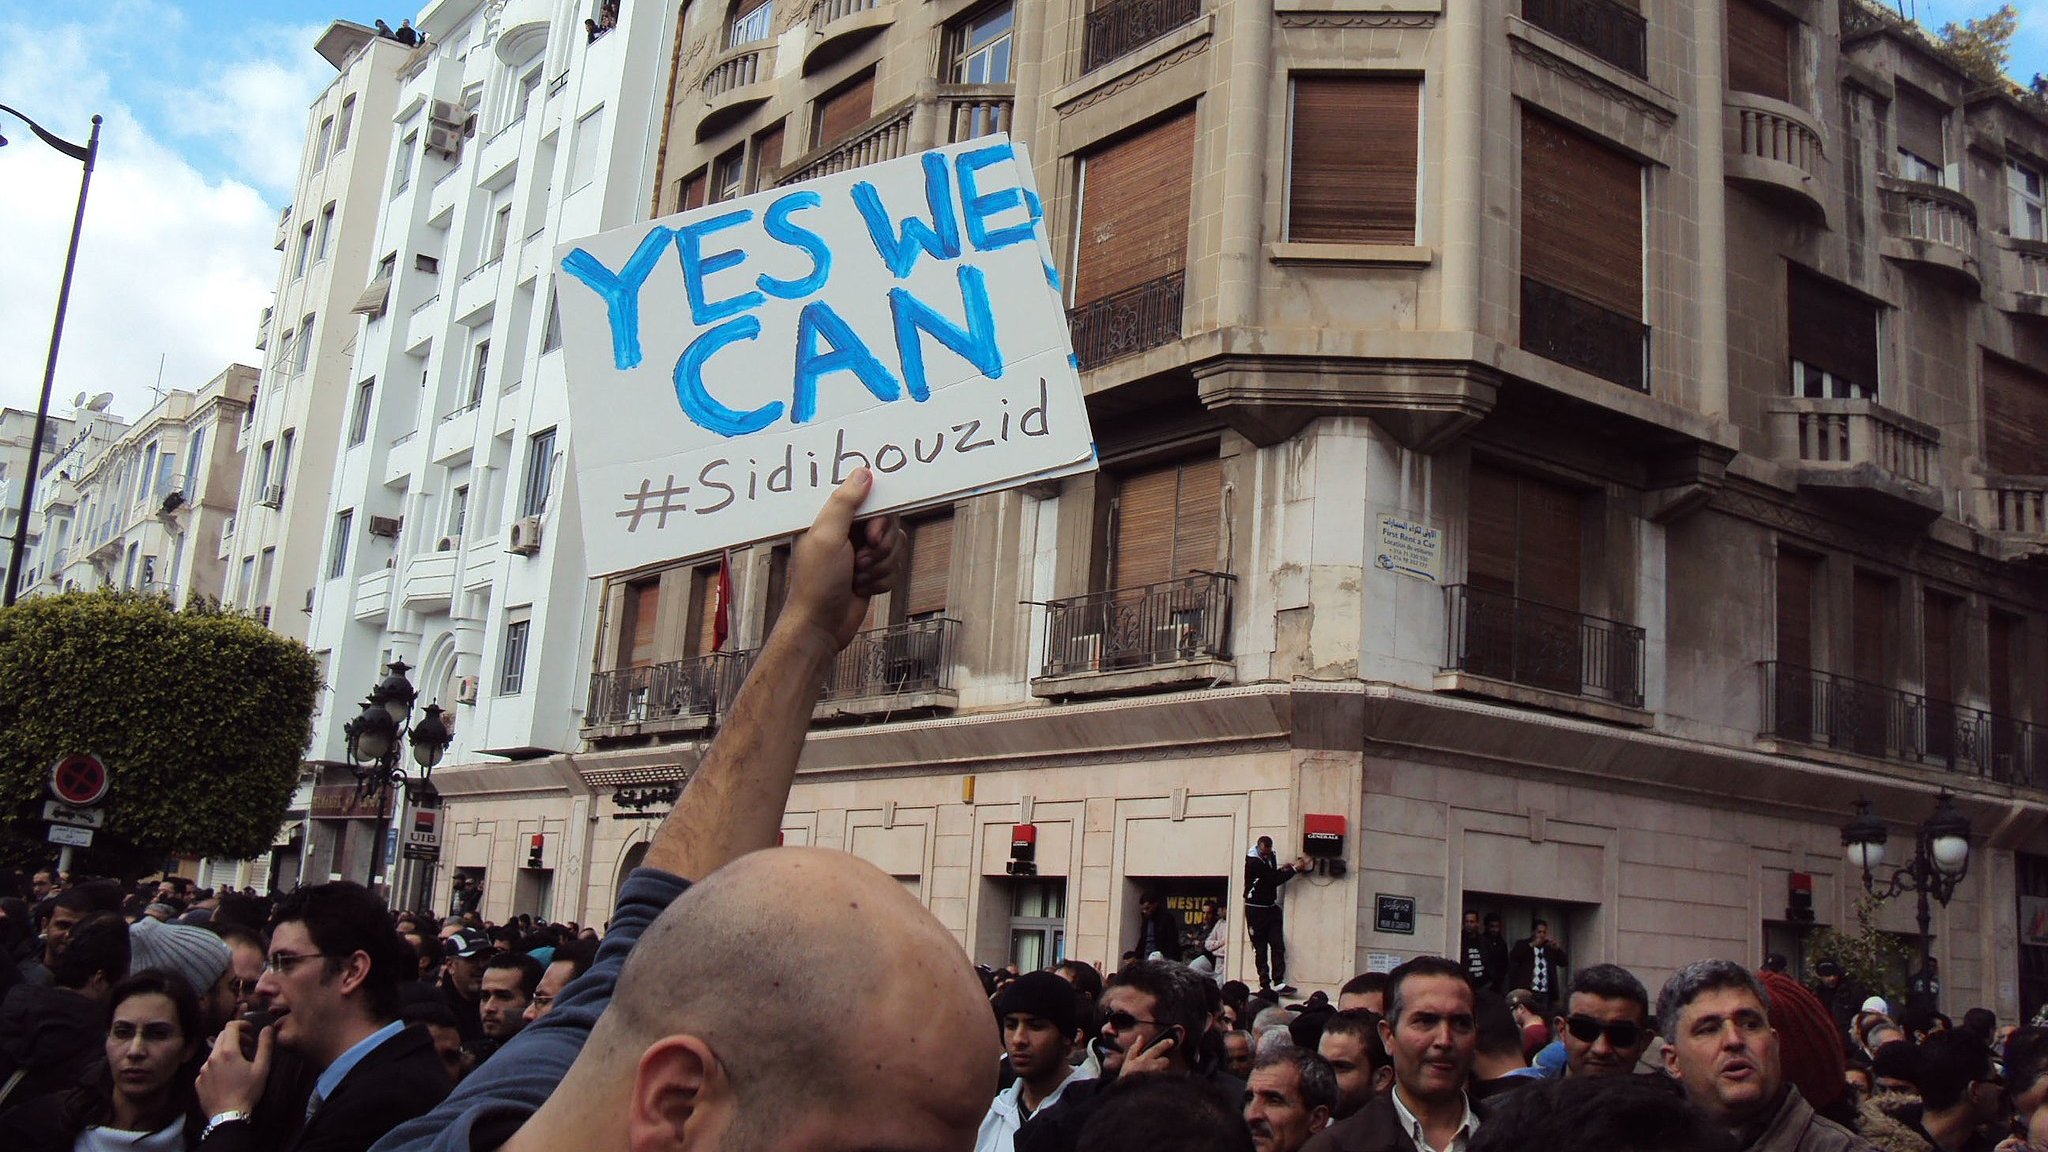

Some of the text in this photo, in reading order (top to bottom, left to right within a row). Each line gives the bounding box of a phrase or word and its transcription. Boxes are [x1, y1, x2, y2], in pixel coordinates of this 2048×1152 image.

[561, 144, 1039, 370] YES WE
[672, 264, 1003, 437] CAN
[615, 377, 1050, 533] #Sidibouzid
[1383, 528, 1398, 539] First
[1400, 532, 1416, 544] Rent
[1423, 539, 1436, 549] Car
[410, 832, 436, 843] UIB
